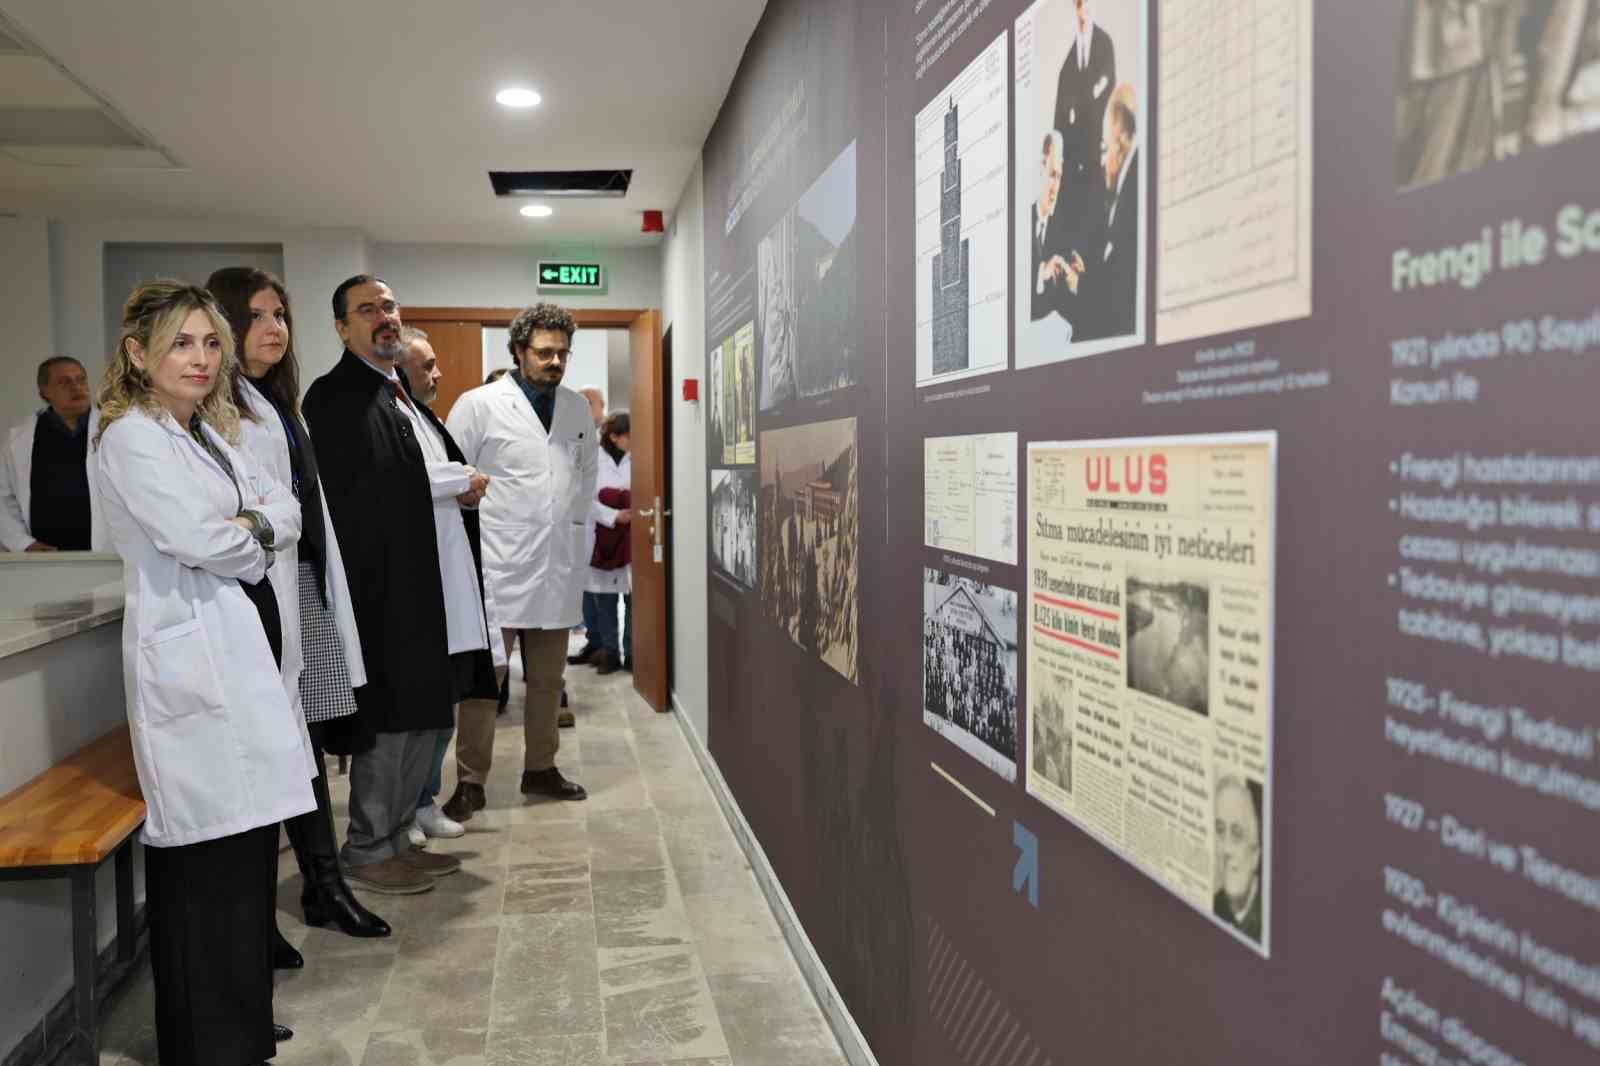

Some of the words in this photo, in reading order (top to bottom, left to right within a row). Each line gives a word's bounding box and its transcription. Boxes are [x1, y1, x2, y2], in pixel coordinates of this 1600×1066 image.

[1391, 225, 1493, 291] Frengi
[1500, 216, 1549, 268] ile
[559, 266, 598, 284] EXIT
[1502, 320, 1537, 354] 90
[1390, 380, 1450, 405] Kanun
[1453, 372, 1480, 402] ile
[1086, 450, 1168, 496] ULUS
[1400, 452, 1458, 490] Frengi
[1500, 494, 1579, 530] bilerek
[1036, 512, 1064, 540] Sıtma
[1067, 518, 1150, 554] mücadelesinin
[1154, 523, 1173, 559] iyi
[1177, 528, 1256, 566] neticeleri
[1400, 566, 1488, 610] Tedaviye
[1489, 627, 1559, 663] yoksa
[1438, 690, 1505, 740] Frengi
[1510, 706, 1594, 760] Tedavi
[1440, 815, 1486, 860] Deri
[1488, 841, 1517, 870] ve
